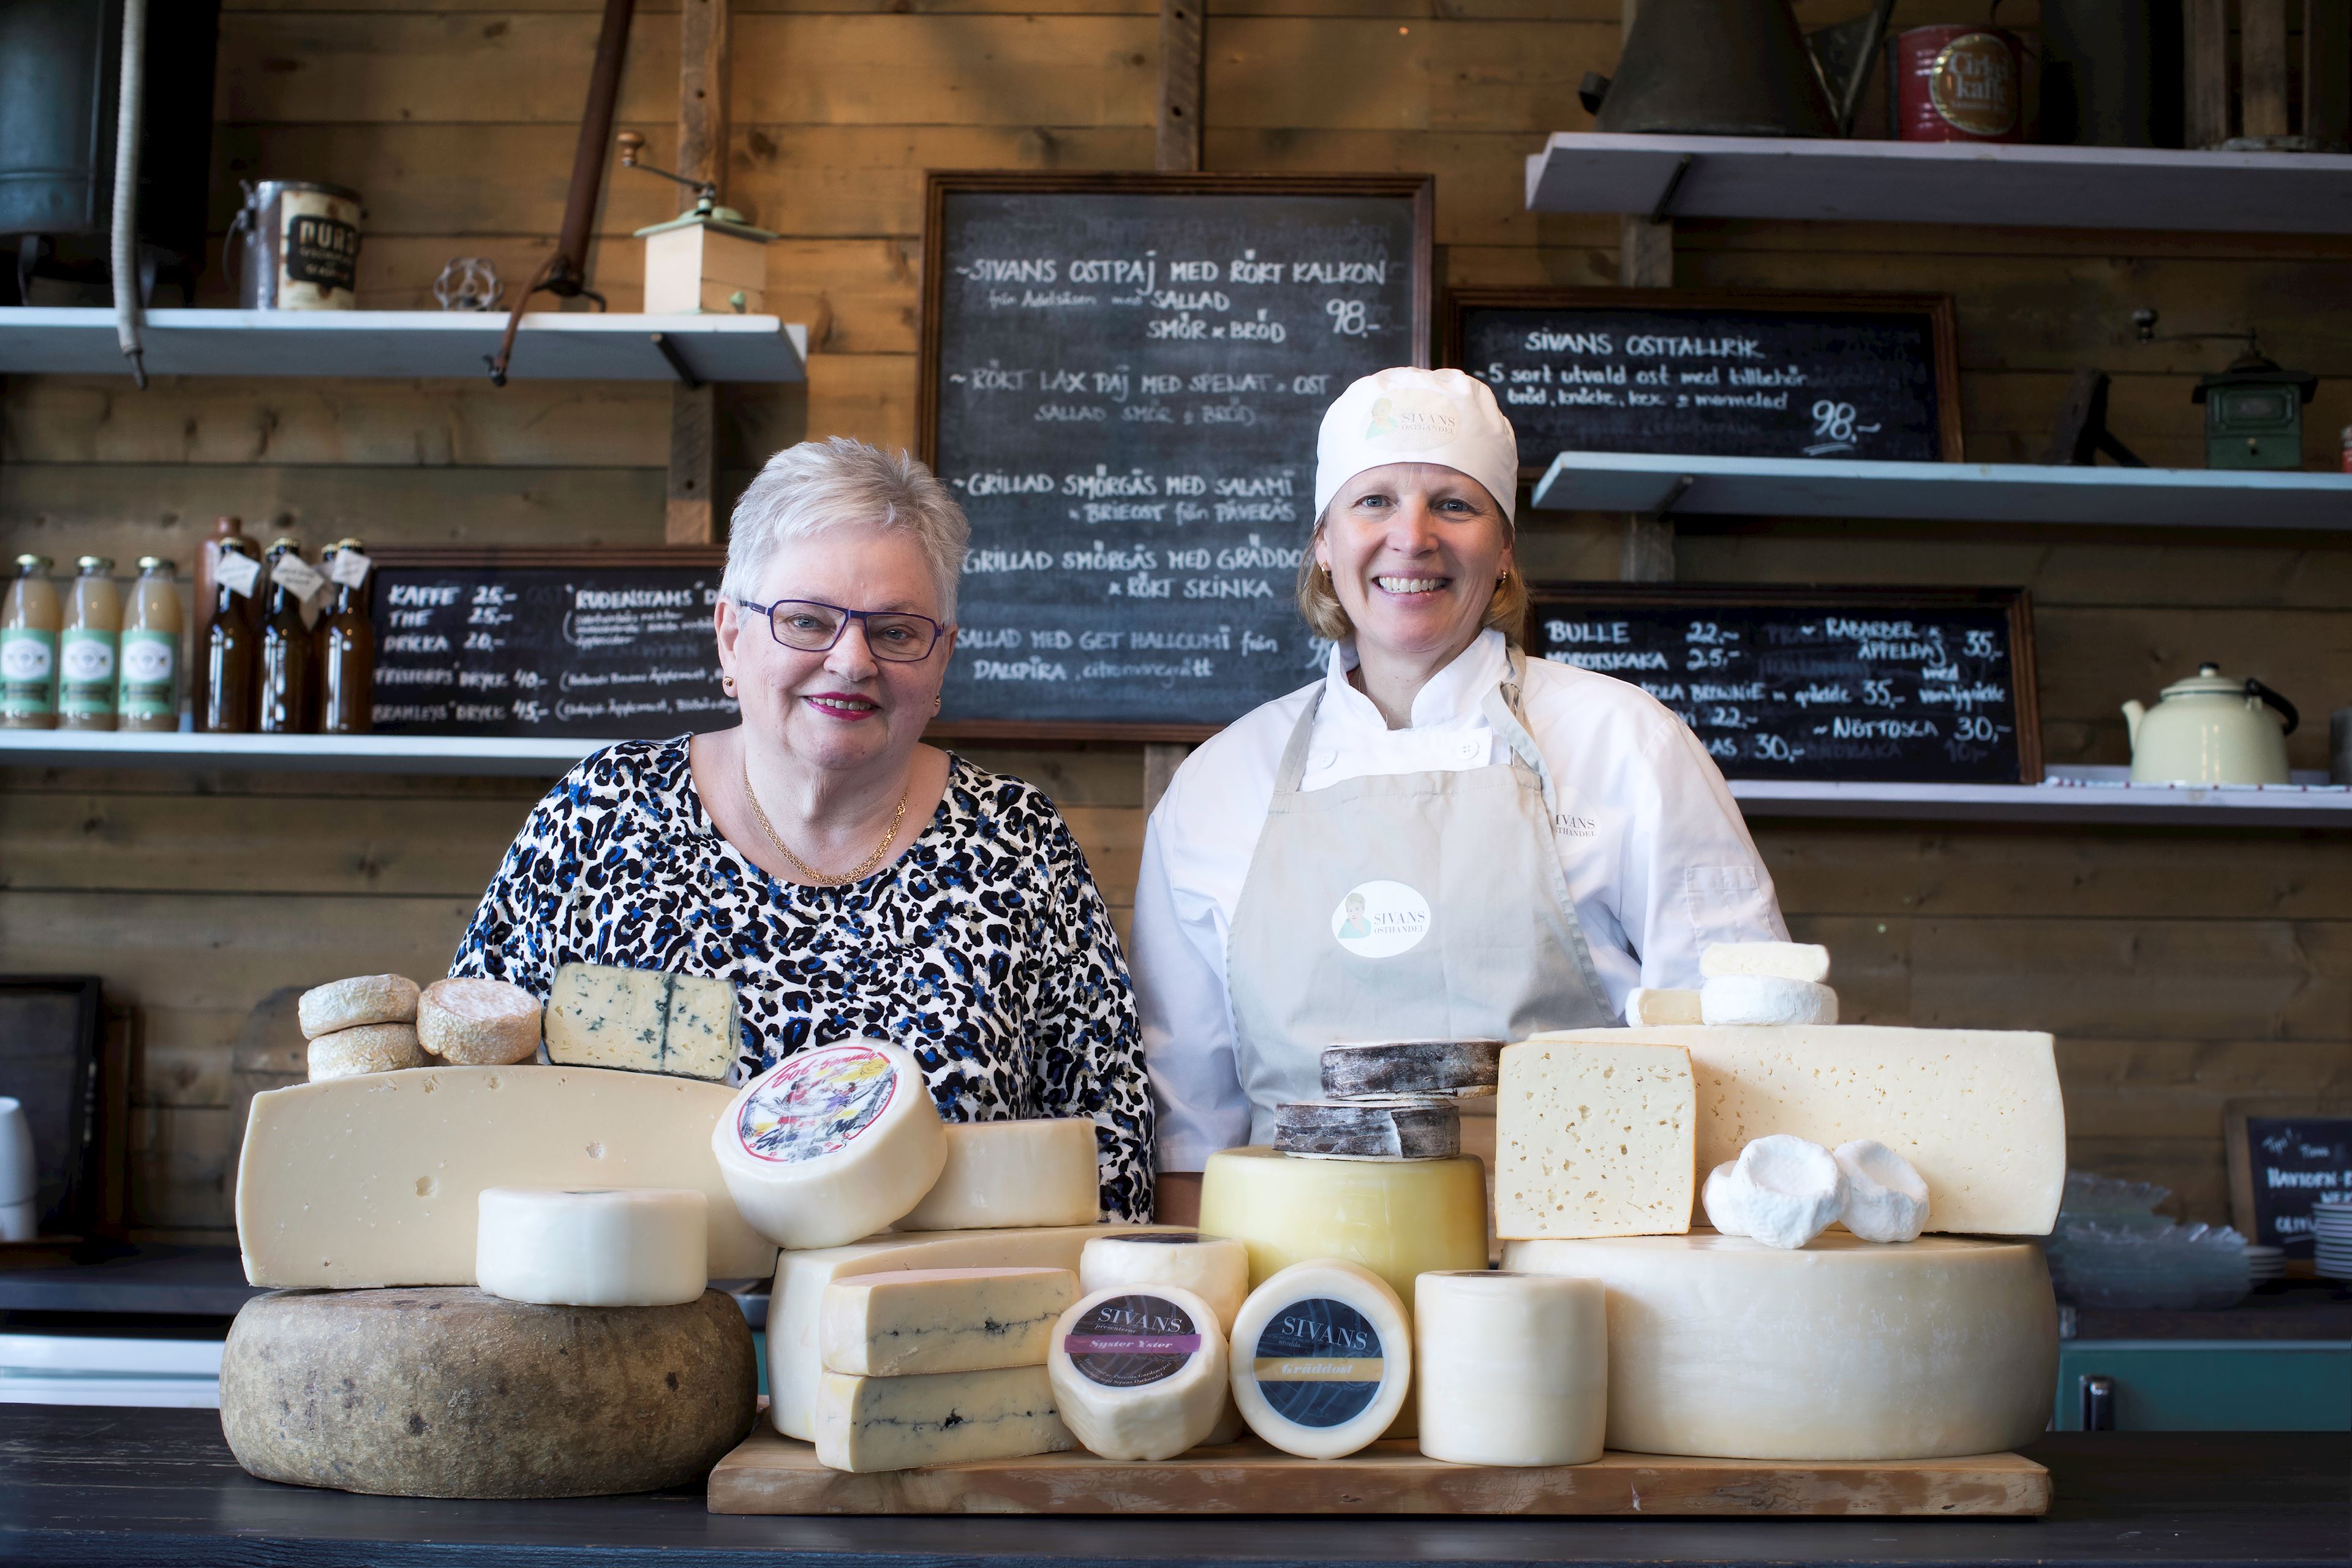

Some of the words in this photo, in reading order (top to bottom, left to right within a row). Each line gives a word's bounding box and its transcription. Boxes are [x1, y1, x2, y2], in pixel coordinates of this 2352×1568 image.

[969, 258, 1057, 282] SIVANS
[1170, 261, 1218, 283] MED
[1230, 249, 1284, 284] RÖKT
[1293, 260, 1385, 285] KALKON
[1151, 290, 1230, 311] SALLAD
[1147, 311, 1208, 339] SMÖR
[1230, 309, 1285, 343] BRÖD
[972, 358, 1034, 390] RÖKT
[1040, 369, 1087, 393] LAX
[1141, 374, 1182, 394] MED
[1293, 374, 1332, 394] OST
[1510, 364, 1552, 383] sort
[1560, 364, 1627, 385] utvald
[1636, 364, 1669, 386] ost
[1681, 367, 1719, 386] med
[1728, 364, 1808, 386] tillbehör
[1628, 390, 1666, 407] kex
[1695, 391, 1788, 410] marmelad
[1035, 405, 1106, 421] SALLAD
[1402, 413, 1455, 427] SIVANS
[1061, 464, 1157, 500] SMÖRGÅS
[1166, 475, 1207, 496] MED
[1061, 539, 1158, 571] SMÖRGÅS
[1167, 548, 1212, 570] MED
[1216, 533, 1307, 570] GRÄDDO
[1128, 571, 1176, 598] RÖKT
[387, 584, 461, 607] KAFFE
[388, 609, 434, 628] THE
[956, 628, 1022, 649] SALLAD
[1030, 629, 1074, 650] MED
[1079, 630, 1126, 650] GET
[1545, 620, 1631, 644] BULLE
[1921, 663, 1959, 681] med
[1556, 813, 1596, 829] IVANS
[1555, 827, 1597, 837] STHANDEL
[1374, 911, 1425, 925] SIVANS
[1374, 925, 1424, 935] OSTHANDEL
[1098, 1308, 1182, 1333] SIVANS
[1089, 1339, 1134, 1349] Syster
[1278, 1340, 1301, 1348] utvalda
[1281, 1316, 1368, 1351] SIVANS
[1281, 1363, 1353, 1374] Gräddost
